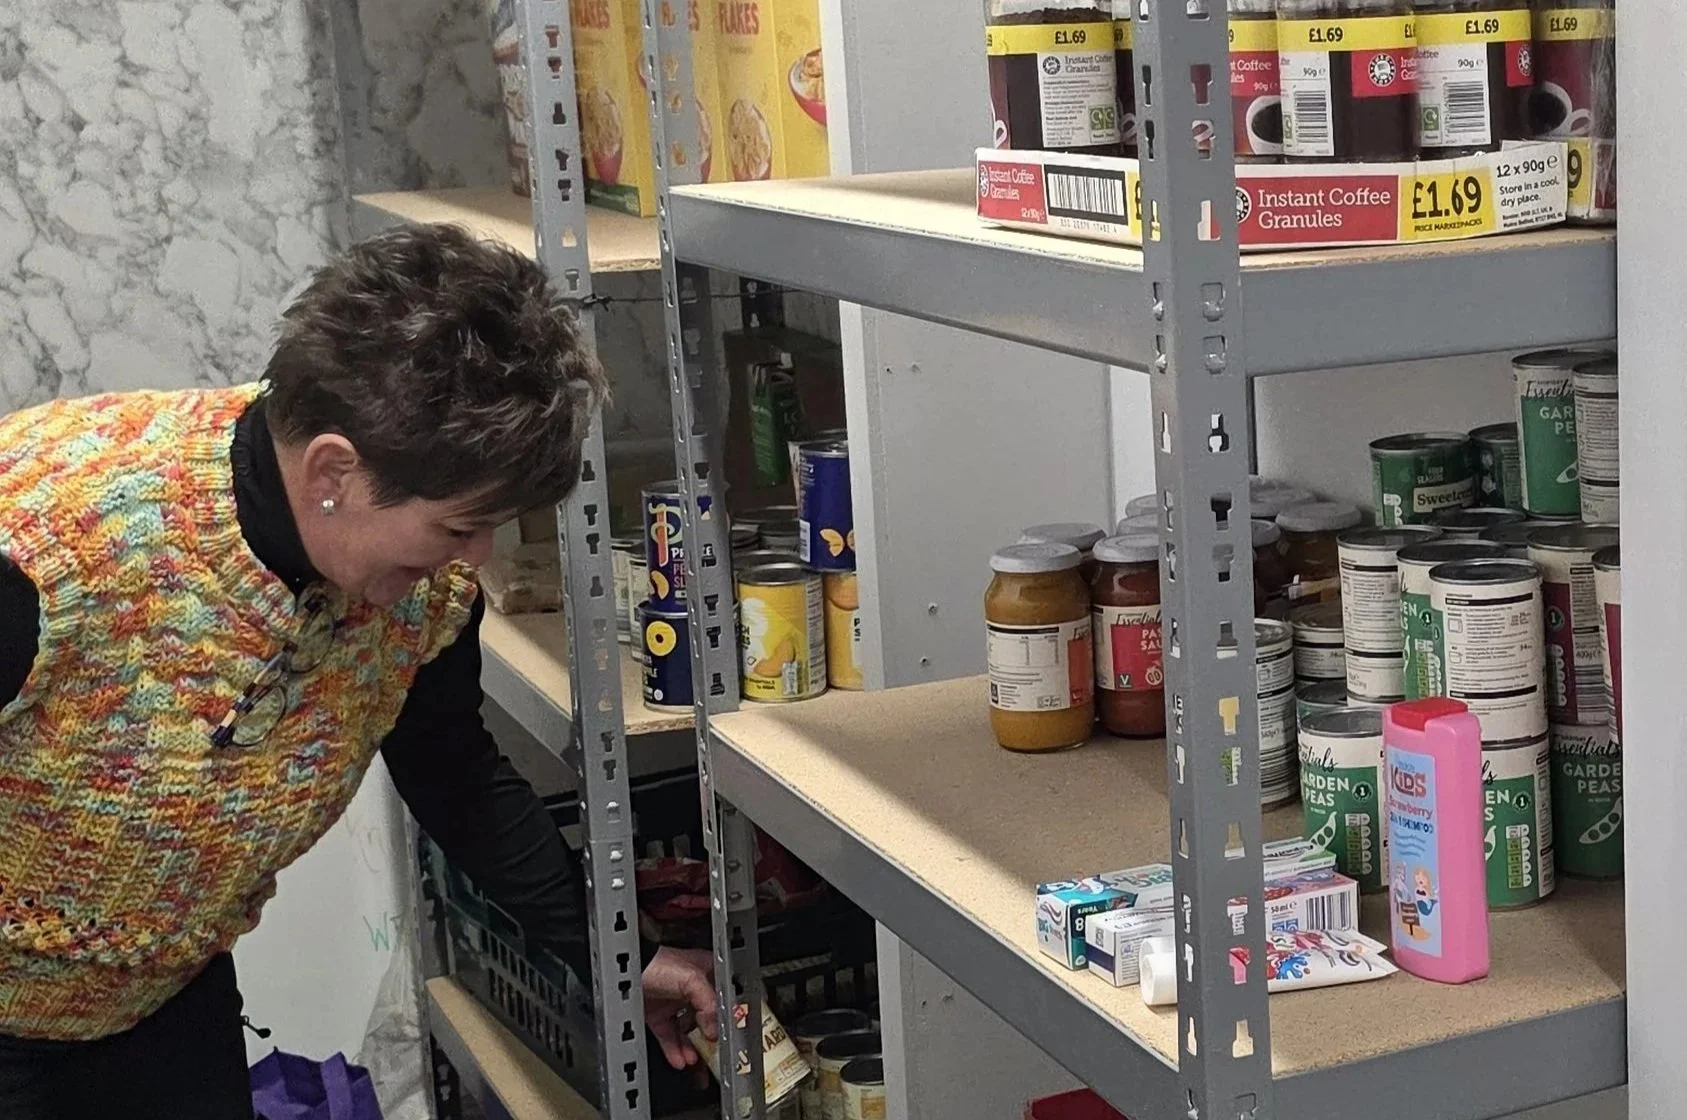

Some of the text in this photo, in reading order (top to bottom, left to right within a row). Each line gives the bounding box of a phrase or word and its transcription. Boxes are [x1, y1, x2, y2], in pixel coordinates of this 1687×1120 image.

[718, 2, 760, 34] FLAKES
[1550, 17, 1578, 32] £1.69
[1466, 19, 1499, 34] £1.69
[1055, 30, 1086, 44] £1.69
[1309, 27, 1343, 42] £1.69
[1237, 60, 1272, 71] Coffee
[1458, 59, 1475, 68] 90g
[1303, 67, 1317, 77] 90g
[989, 166, 1035, 185] Instant Coffee
[1497, 164, 1511, 178] 12
[1513, 167, 1521, 175] x
[1522, 159, 1545, 174] 90g
[990, 183, 1020, 200] Granules
[1499, 183, 1523, 195] Store
[1524, 182, 1532, 190] in
[1534, 180, 1539, 188] a
[1258, 188, 1391, 208] Instant Coffee
[1412, 176, 1482, 219] £1.69
[1501, 193, 1541, 208] dry place.
[1258, 209, 1343, 230] Granules
[1578, 779, 1621, 794] PEAS
[1305, 788, 1335, 807] PEAS
[1078, 905, 1099, 915] Years
